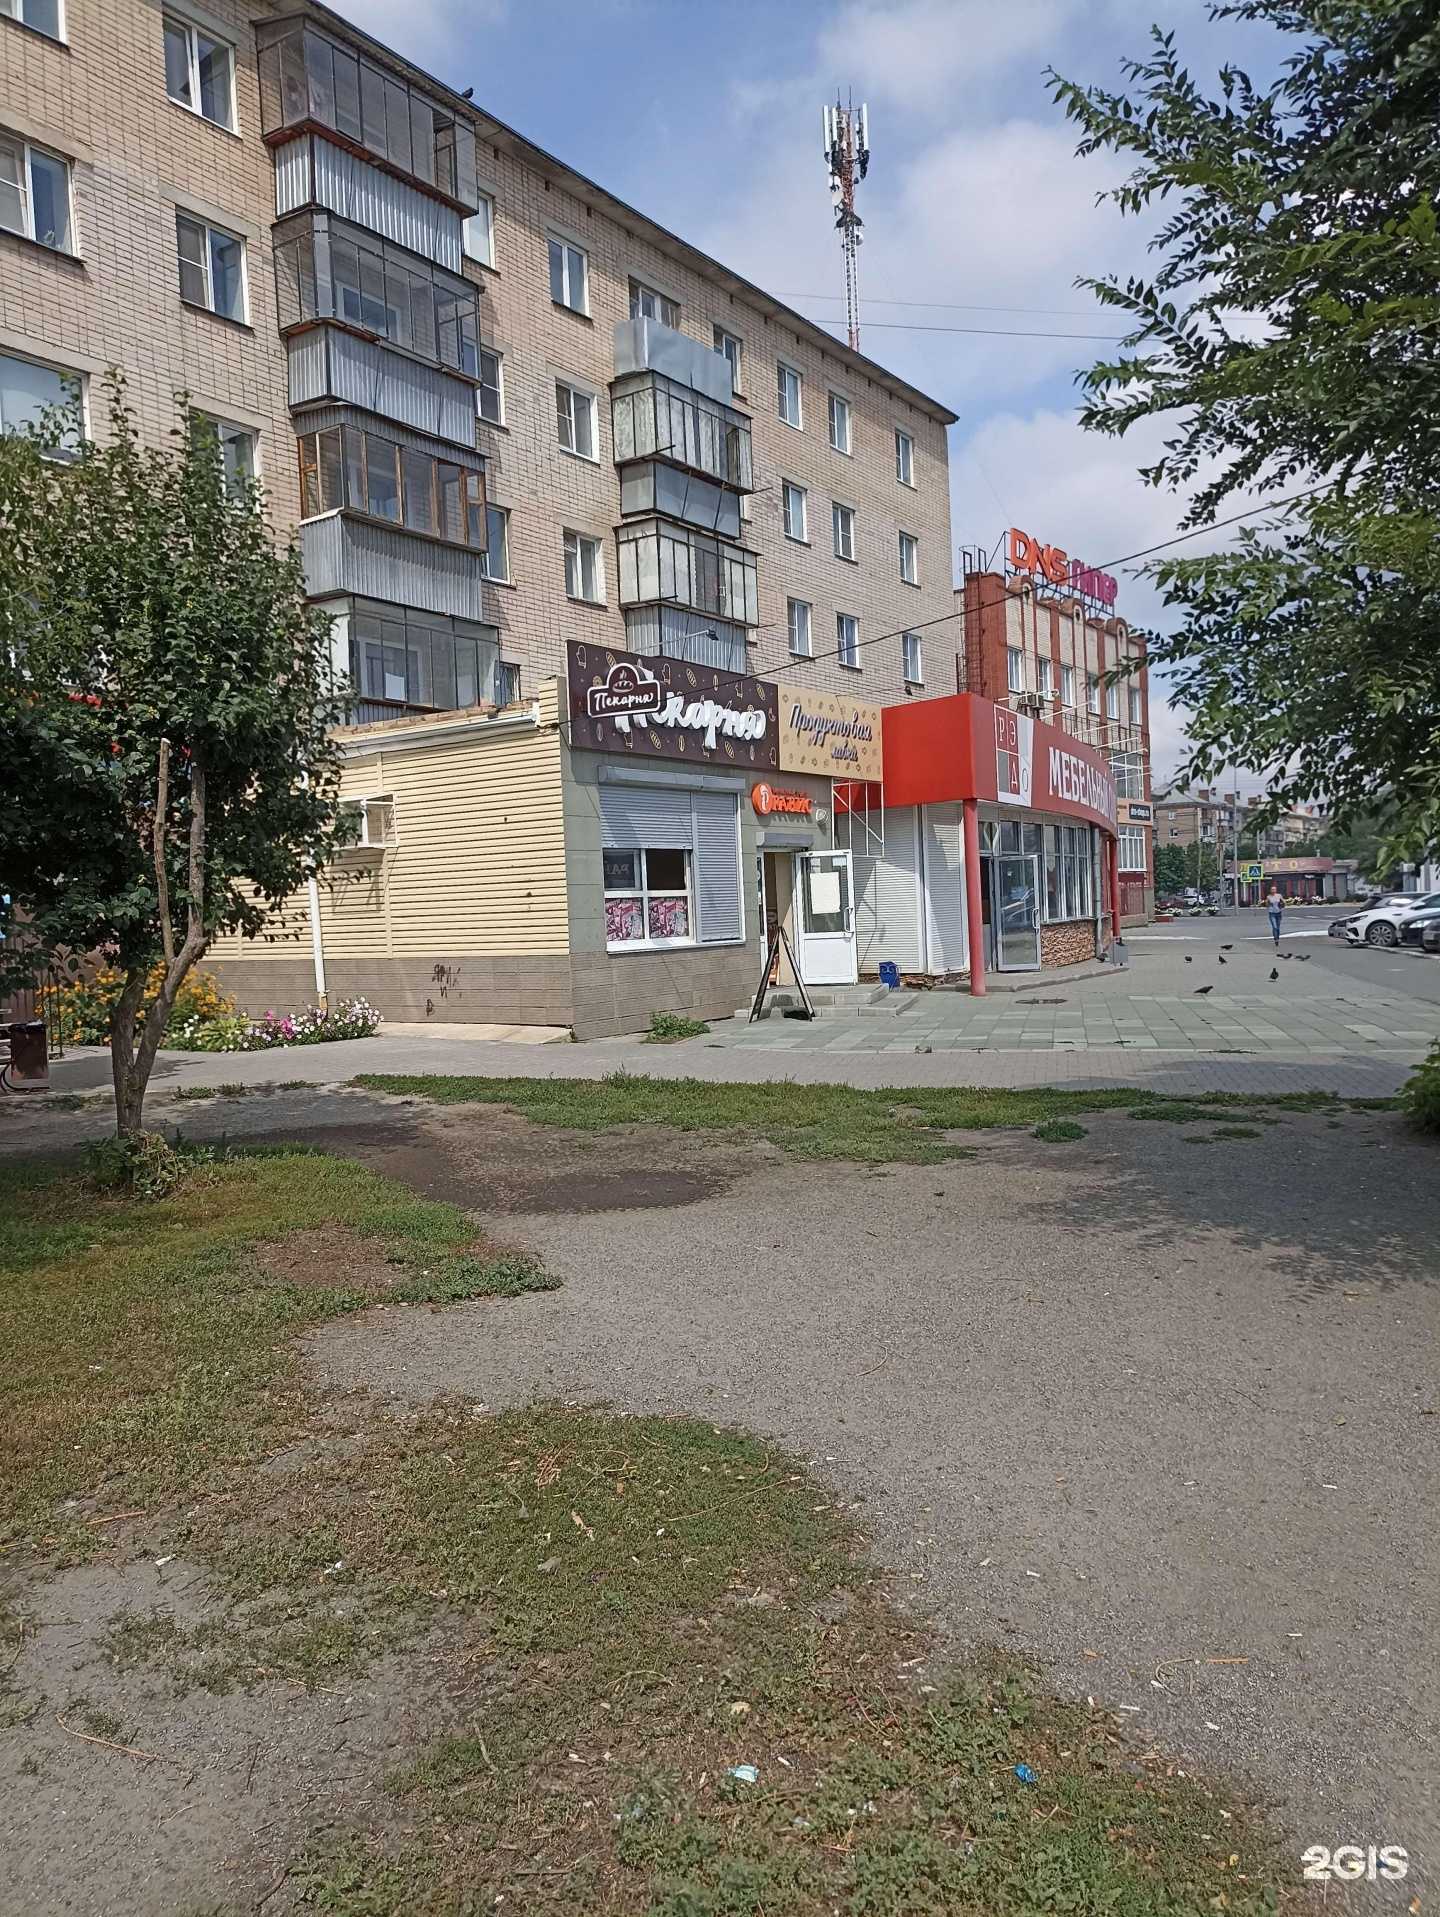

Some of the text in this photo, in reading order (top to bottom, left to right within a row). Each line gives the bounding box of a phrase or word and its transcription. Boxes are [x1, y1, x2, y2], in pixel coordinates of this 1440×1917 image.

[1010, 527, 1067, 586] DNS
[594, 691, 654, 711] Пекарня
[789, 703, 872, 747] Продуктовая
